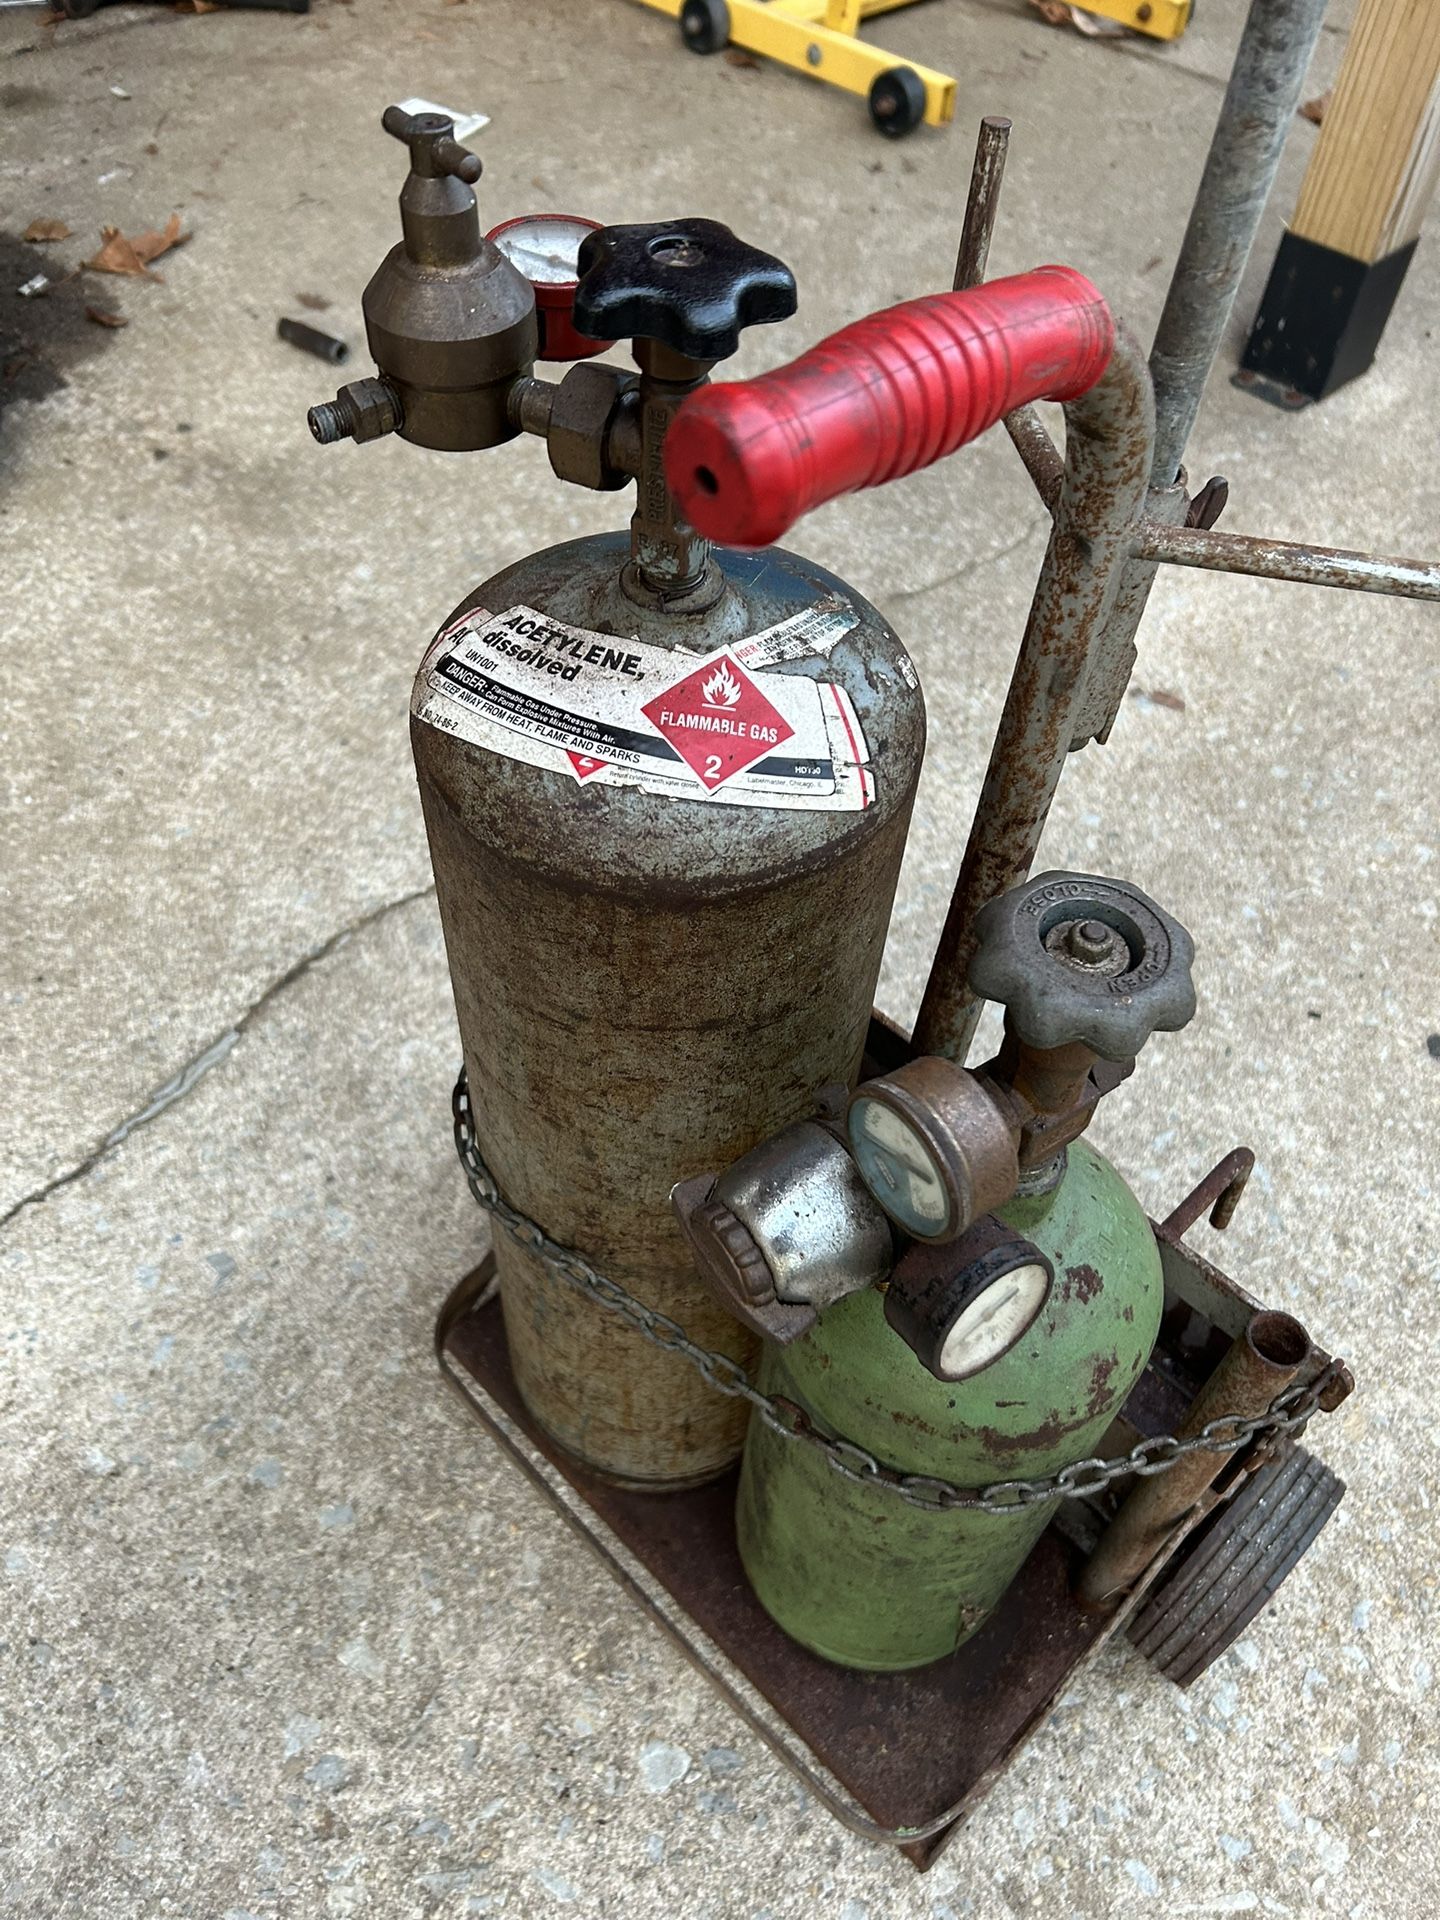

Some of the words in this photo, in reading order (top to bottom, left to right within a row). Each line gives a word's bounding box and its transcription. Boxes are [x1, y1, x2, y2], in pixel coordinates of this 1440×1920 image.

[465, 649, 498, 672] UN1001
[483, 631, 582, 681] dissolved
[503, 615, 645, 681] ACETYLENE,
[446, 662, 488, 692] DANGER:
[441, 680, 461, 695] KEEP
[458, 690, 483, 708] AWAY
[480, 702, 507, 719] FROM
[506, 713, 533, 732] HEAT,
[535, 725, 568, 744] FLAME
[570, 737, 594, 751] AND
[595, 745, 641, 764] SPARKS
[485, 691, 498, 702] Can
[497, 696, 515, 709] Form
[515, 704, 549, 723] Explosive
[548, 717, 581, 734] Mixtures
[583, 728, 601, 740] With
[602, 734, 616, 745] Air.
[491, 685, 525, 704] Flammable
[526, 700, 539, 711] Gas
[540, 706, 562, 719] Under
[563, 713, 599, 731] Pressure.
[660, 711, 747, 737] FLAMMABLE
[750, 724, 778, 744] GAS
[703, 754, 723, 779] 2
[1018, 883, 1080, 916] CLOSE
